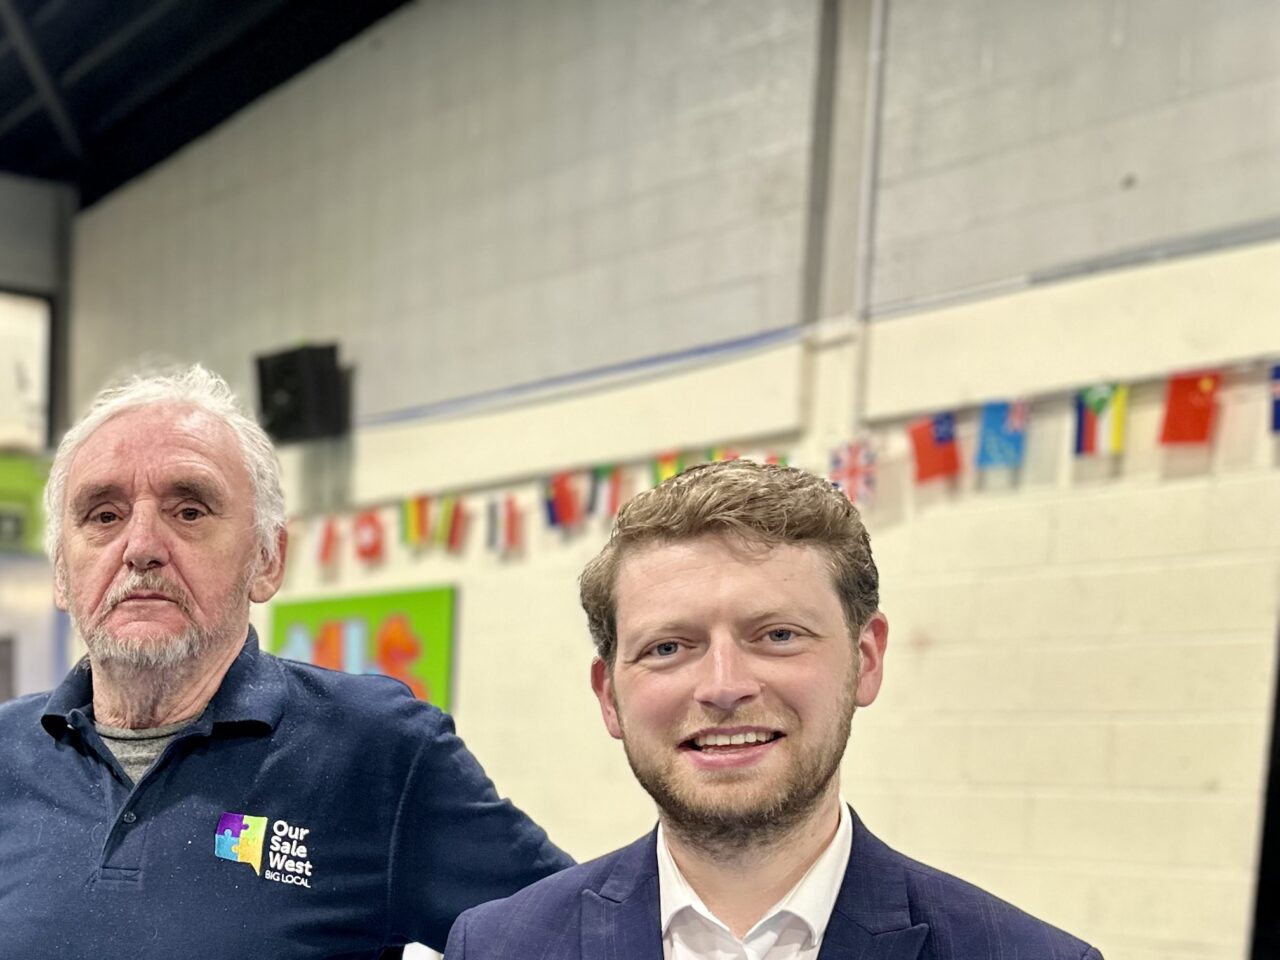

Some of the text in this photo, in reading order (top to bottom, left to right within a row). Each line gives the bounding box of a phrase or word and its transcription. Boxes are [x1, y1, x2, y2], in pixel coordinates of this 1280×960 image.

[273, 820, 310, 840] Our
[269, 836, 308, 858] Sale
[269, 851, 313, 877] West
[264, 869, 312, 889] BIG LOCAL
